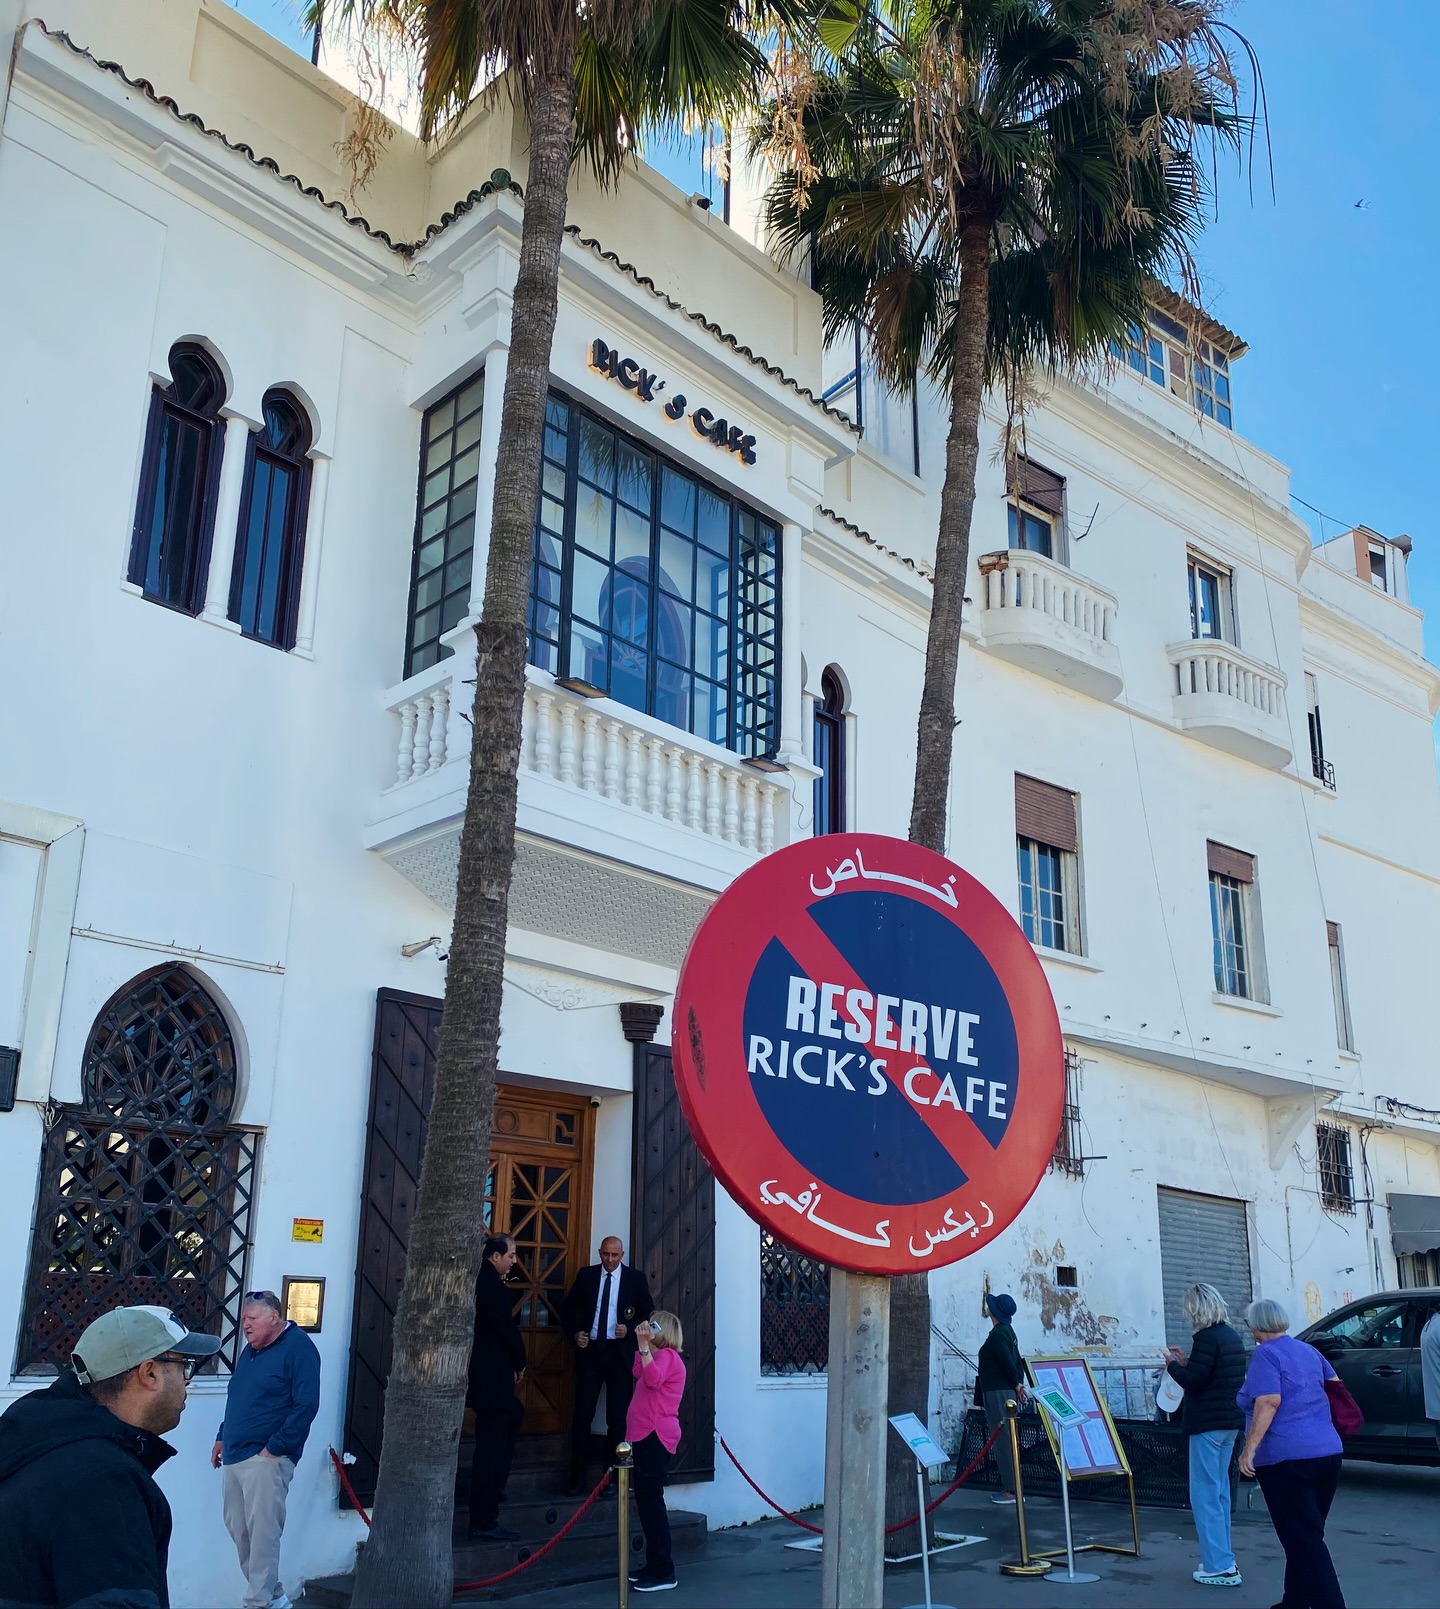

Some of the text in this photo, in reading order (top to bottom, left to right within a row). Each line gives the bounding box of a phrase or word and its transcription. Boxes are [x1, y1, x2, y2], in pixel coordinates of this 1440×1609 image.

[690, 407, 757, 466] CAFE
[809, 847, 959, 909] خاص
[786, 975, 980, 1066] RESERVE
[747, 1035, 1007, 1120] RICK'S CAFE
[759, 1179, 994, 1257] ريكس كافي
